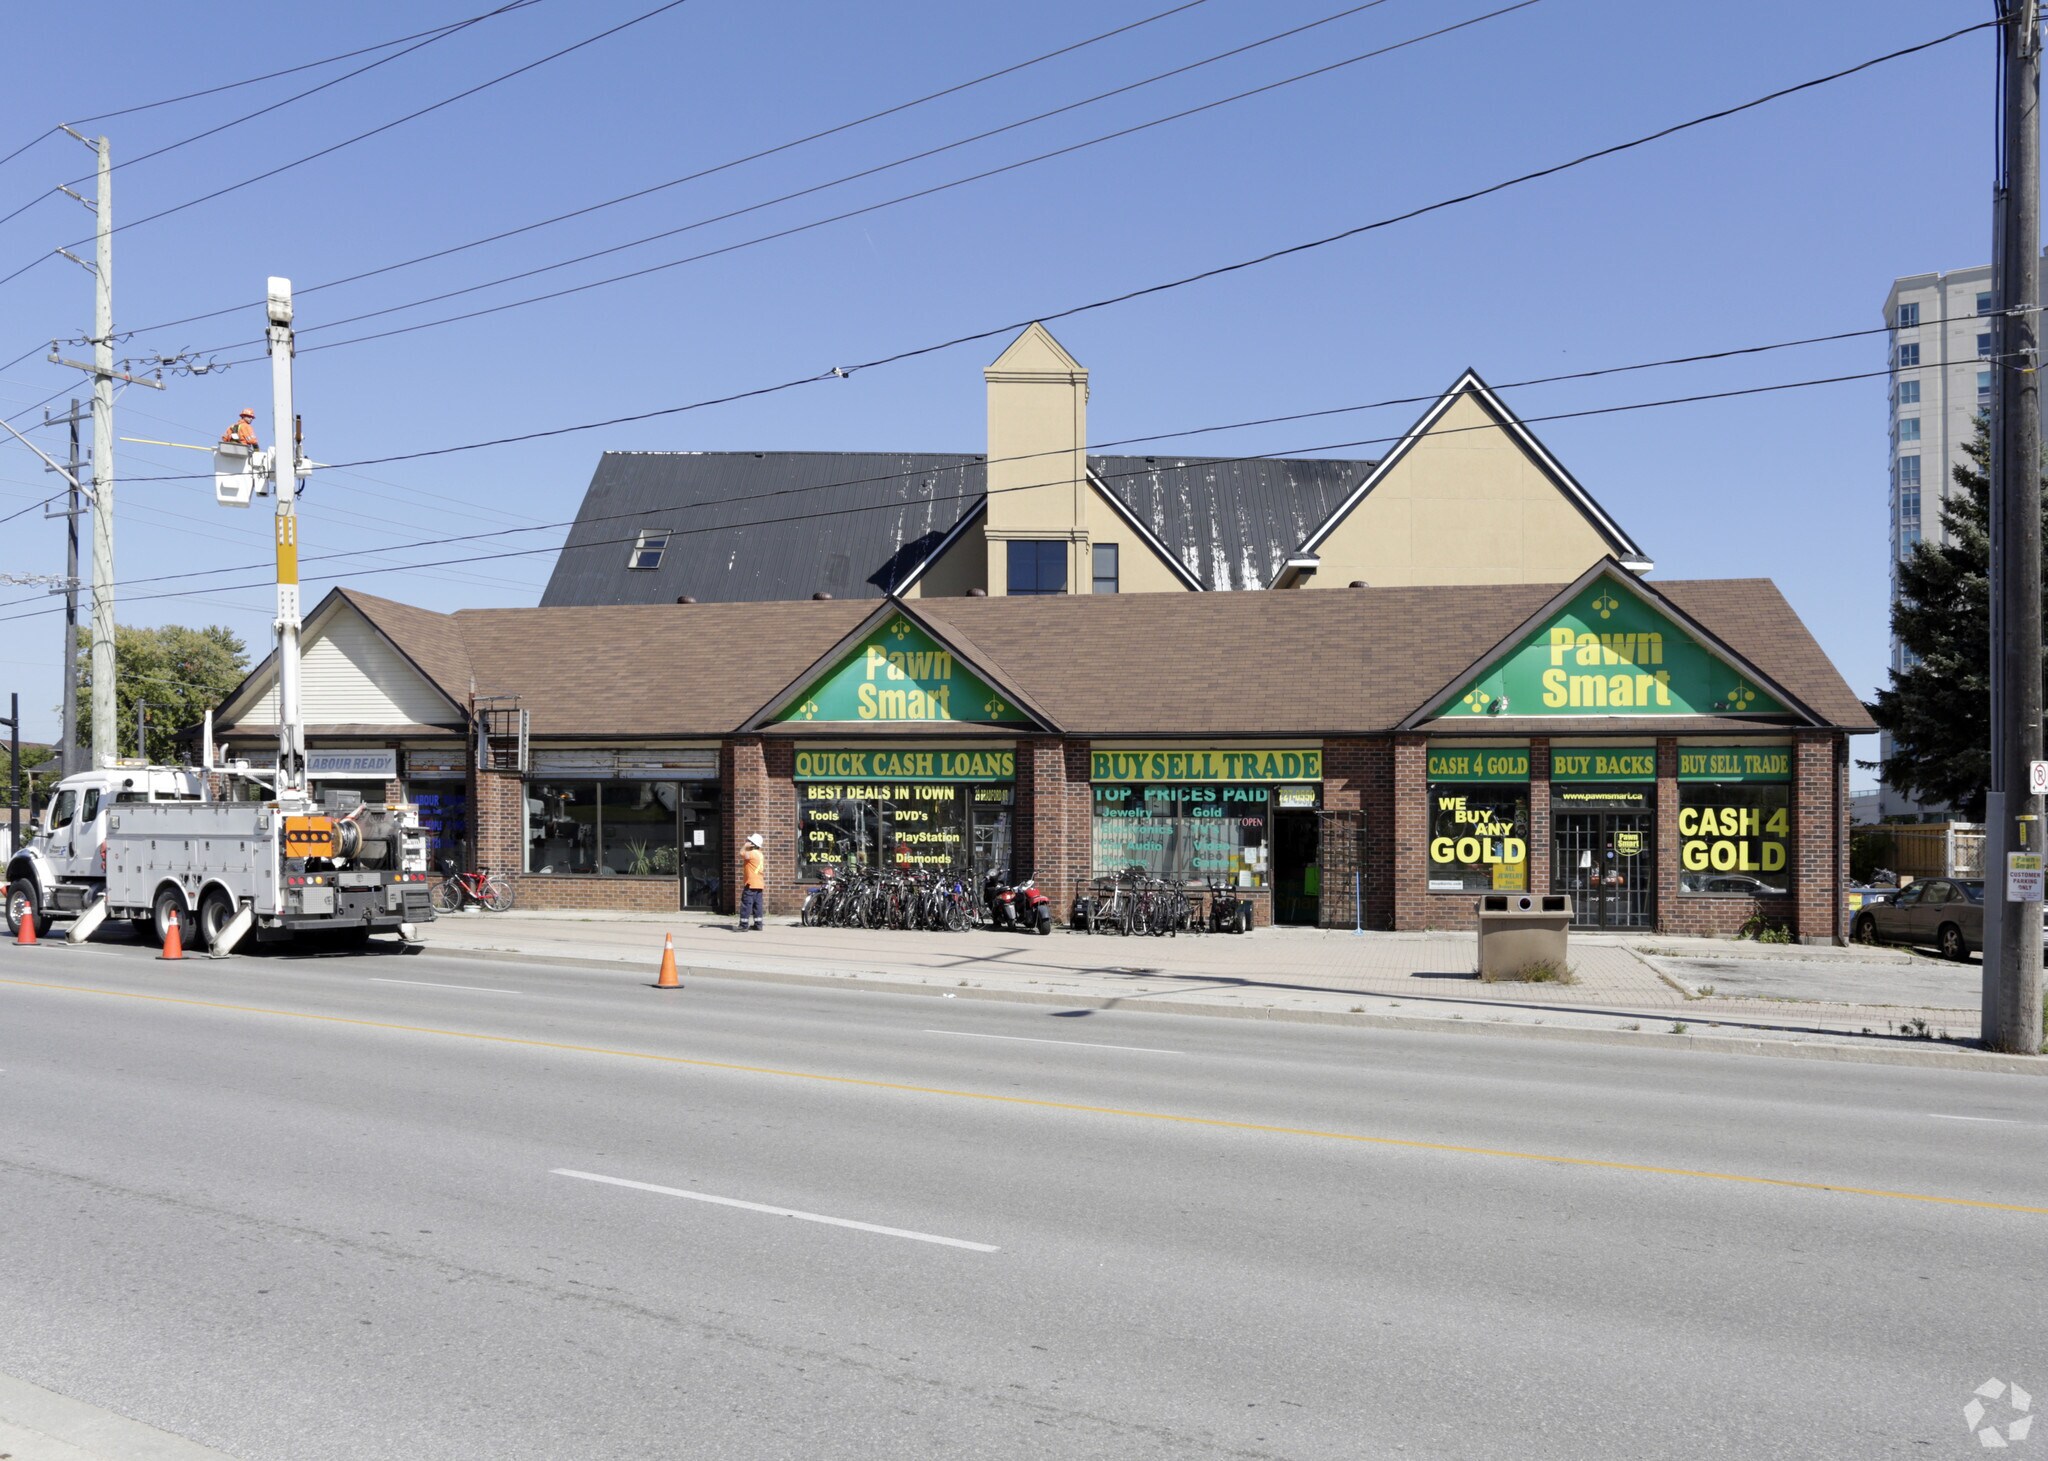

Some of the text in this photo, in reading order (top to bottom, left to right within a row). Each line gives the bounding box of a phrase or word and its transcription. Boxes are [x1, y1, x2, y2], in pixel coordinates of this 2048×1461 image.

[1550, 627, 1663, 666] Pawn
[866, 644, 952, 681] Pawn
[1542, 668, 1672, 708] Smart
[858, 682, 951, 720] Smart
[307, 757, 392, 770] LABOUR READY
[795, 752, 1014, 778] QUICK CASH LOANS
[1092, 752, 1320, 780] BUY SELL TRADE
[1429, 752, 1528, 776] CASH 4 GOLD
[1554, 755, 1654, 774] BUY BACKS
[1680, 755, 1788, 773] BUY SELL TRADE
[808, 785, 954, 800] BEST DEALS IN TOWN
[1094, 786, 1269, 802] TOP PRICES PAID
[1562, 792, 1643, 802] www.pawnsmart.ca
[1439, 797, 1466, 811] WE
[808, 810, 839, 821] Tools
[895, 810, 928, 821] DVD's
[1102, 806, 1153, 819] Jewelry
[1192, 807, 1222, 818] Gold
[1455, 811, 1492, 824] BUY
[1101, 822, 1174, 835] Electronics
[1241, 817, 1263, 827] OPEN
[1678, 807, 1789, 837] CASH 4
[1474, 823, 1514, 836] ANY
[809, 831, 833, 842] CD's
[895, 831, 960, 844] PlayStation
[1619, 833, 1638, 841] Pawn
[1127, 840, 1163, 851] Audio
[1192, 841, 1231, 851] Video
[1430, 837, 1527, 864] GOLD
[809, 853, 842, 863] X-Box
[895, 853, 952, 864] Diamonds
[1682, 839, 1786, 871] GOLD
